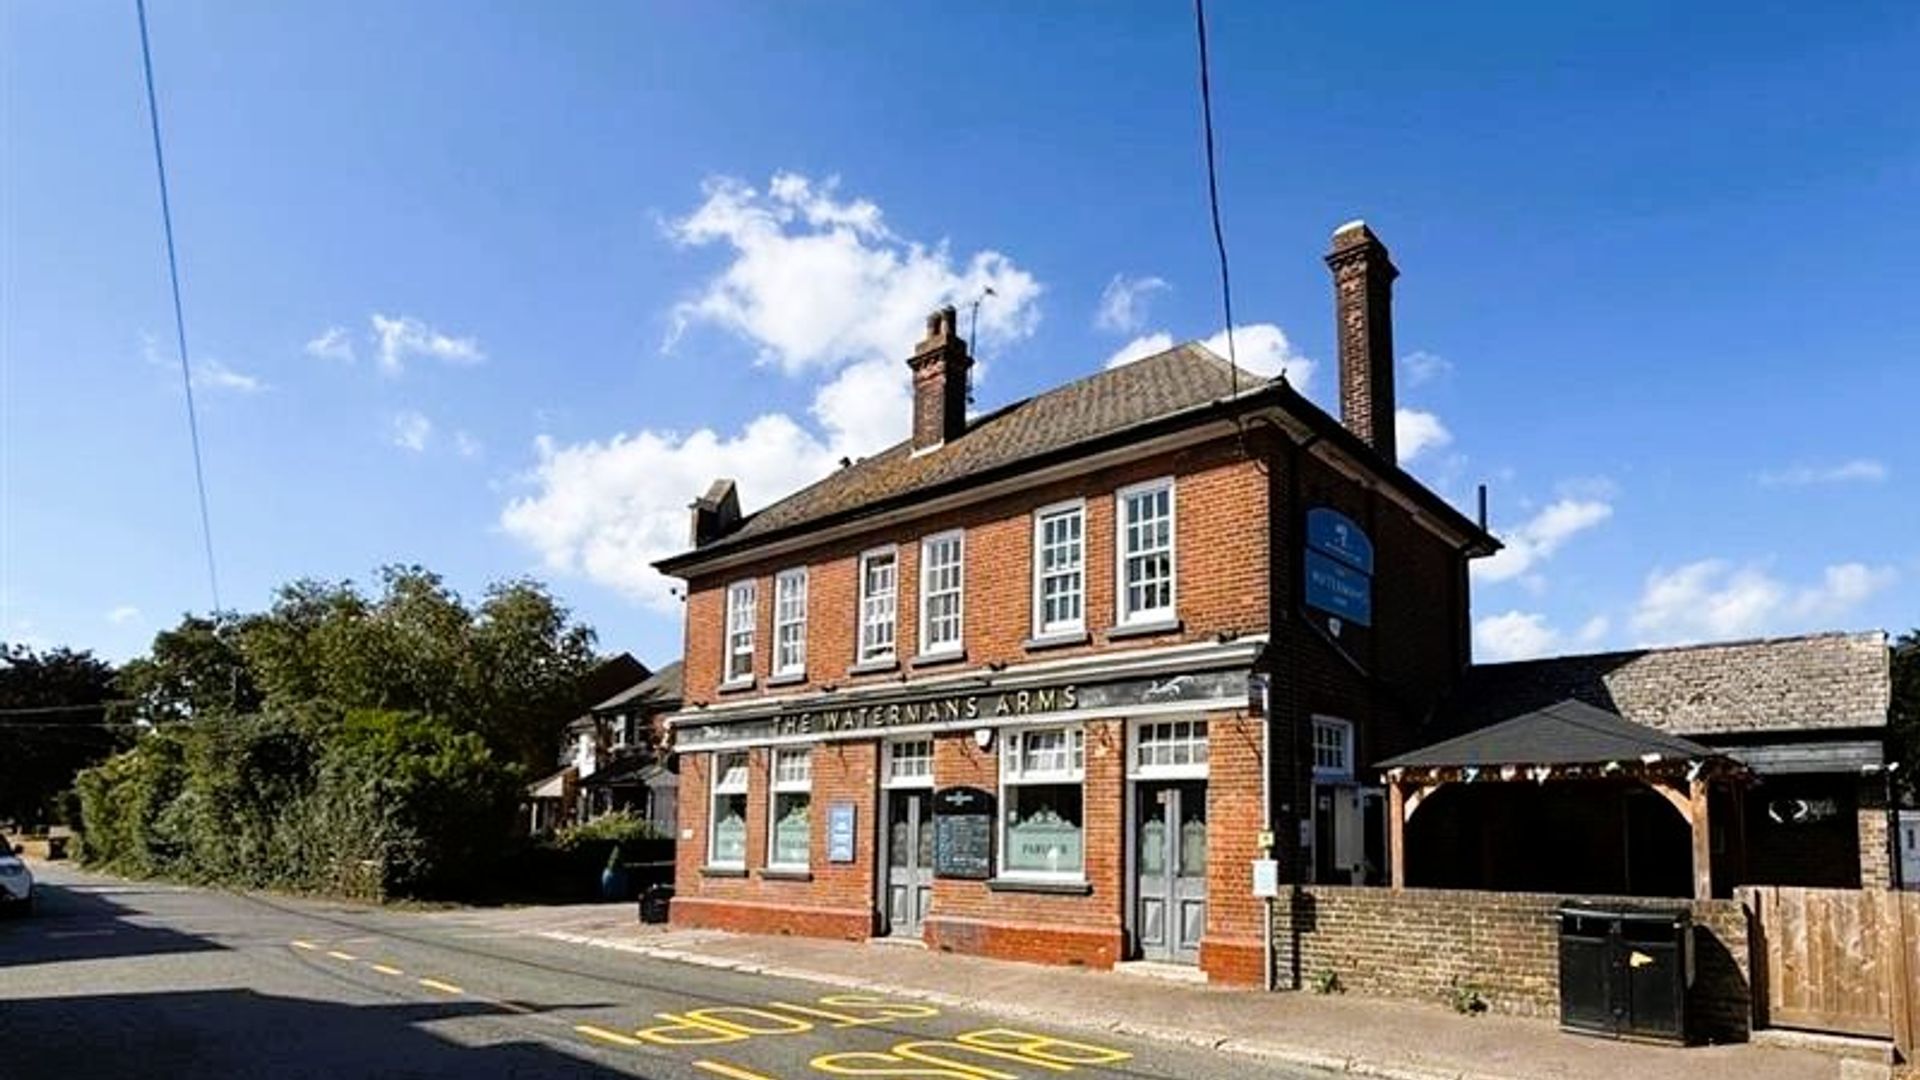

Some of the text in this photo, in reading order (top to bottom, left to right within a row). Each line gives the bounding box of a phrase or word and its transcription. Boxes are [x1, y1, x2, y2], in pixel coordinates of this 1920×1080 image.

[772, 685, 1078, 735] THE WATERMANS ARMS
[637, 995, 940, 1044] STOP
[810, 1028, 1134, 1080] BUS
